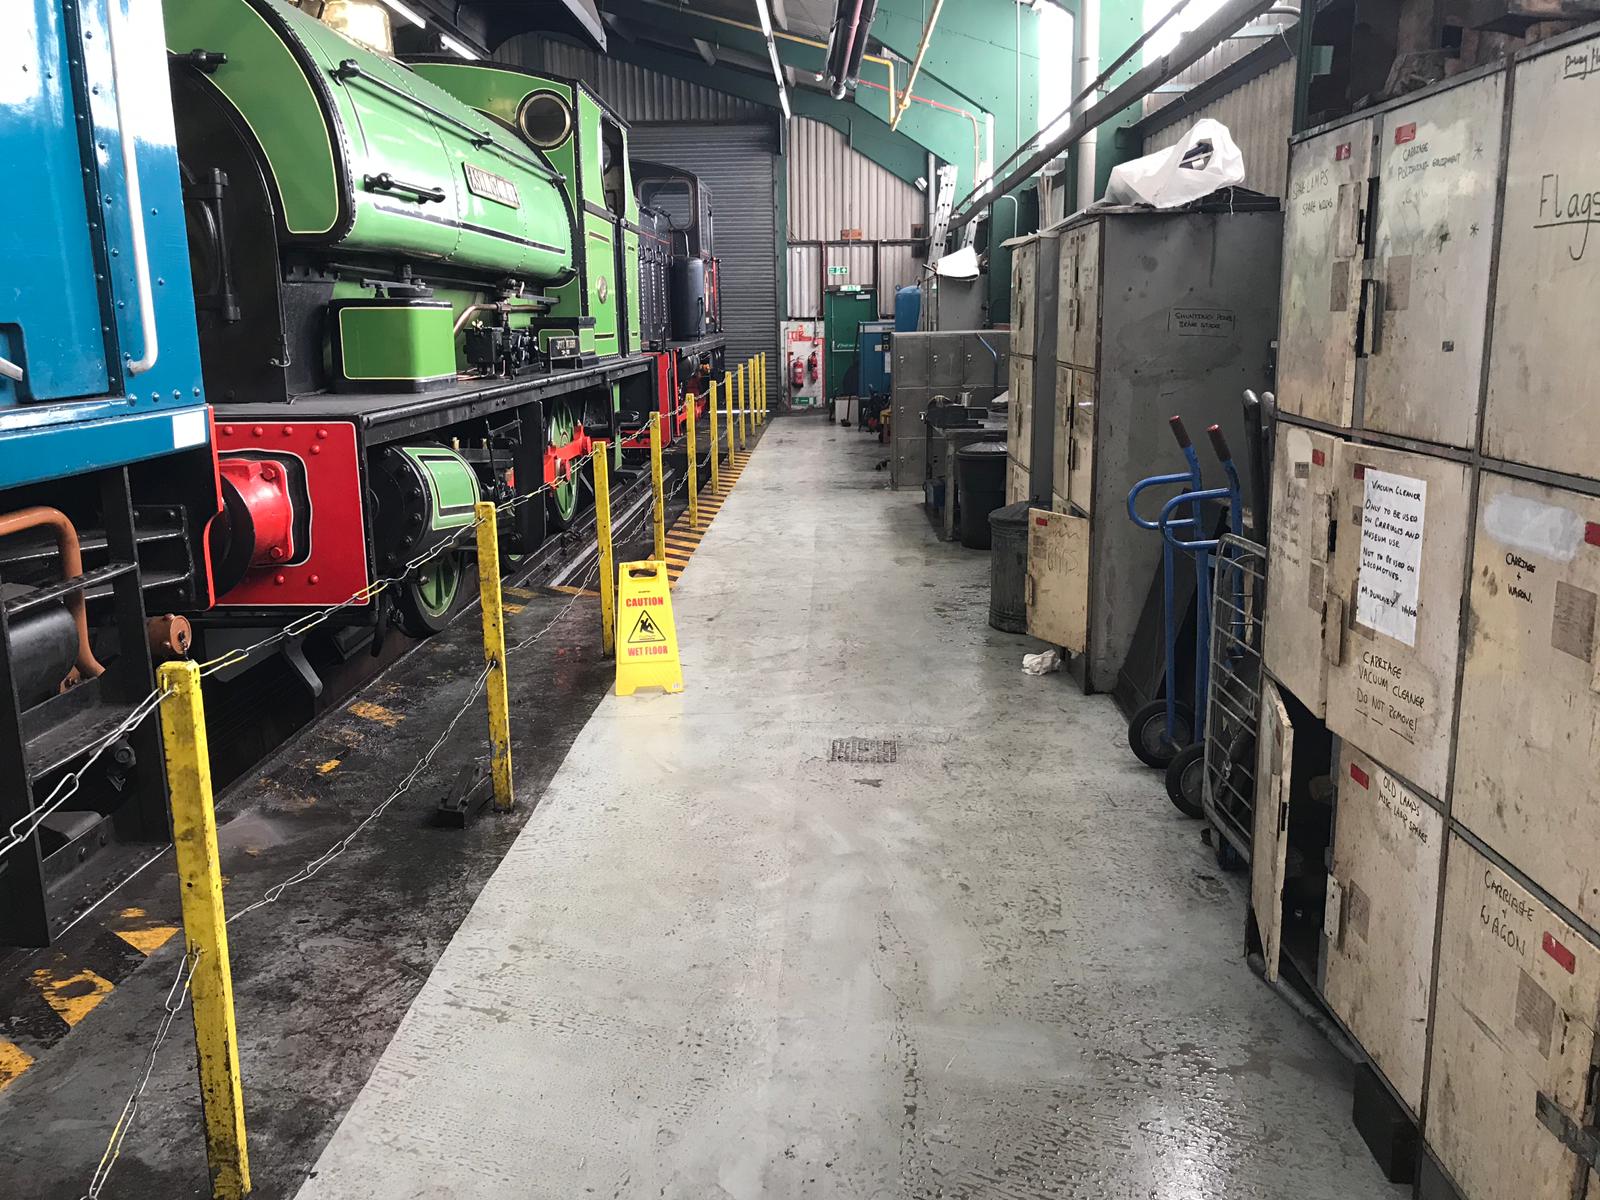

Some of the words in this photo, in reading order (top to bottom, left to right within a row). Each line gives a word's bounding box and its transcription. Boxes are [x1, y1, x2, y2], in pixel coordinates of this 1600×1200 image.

[1539, 173, 1600, 261] Flags
[1371, 479, 1394, 494] VACUUM
[1395, 485, 1421, 502] CLEANER
[1365, 498, 1381, 513] ONLY
[1384, 507, 1391, 515] TO
[1393, 510, 1401, 519] BE
[1402, 513, 1418, 523] USED
[1363, 529, 1387, 543] MUSEUM
[1365, 515, 1373, 523] ON
[1374, 517, 1404, 536] CARRIAGES
[1405, 530, 1420, 540] AND
[1362, 547, 1375, 557] NOT
[1385, 554, 1393, 565] BE
[1393, 559, 1405, 569] USED
[1406, 565, 1415, 573] ON
[626, 596, 664, 608] CAUTION
[627, 647, 643, 657] WET
[645, 645, 669, 656] FLOOR
[1358, 664, 1388, 691] VACUUM
[1362, 651, 1402, 679] CARRIAGE
[1371, 695, 1386, 712] NOT
[1383, 775, 1397, 798] OLD
[1400, 790, 1420, 817] LAMPS
[1484, 870, 1535, 922] CARRIAGE
[1480, 904, 1526, 957] WAGON
